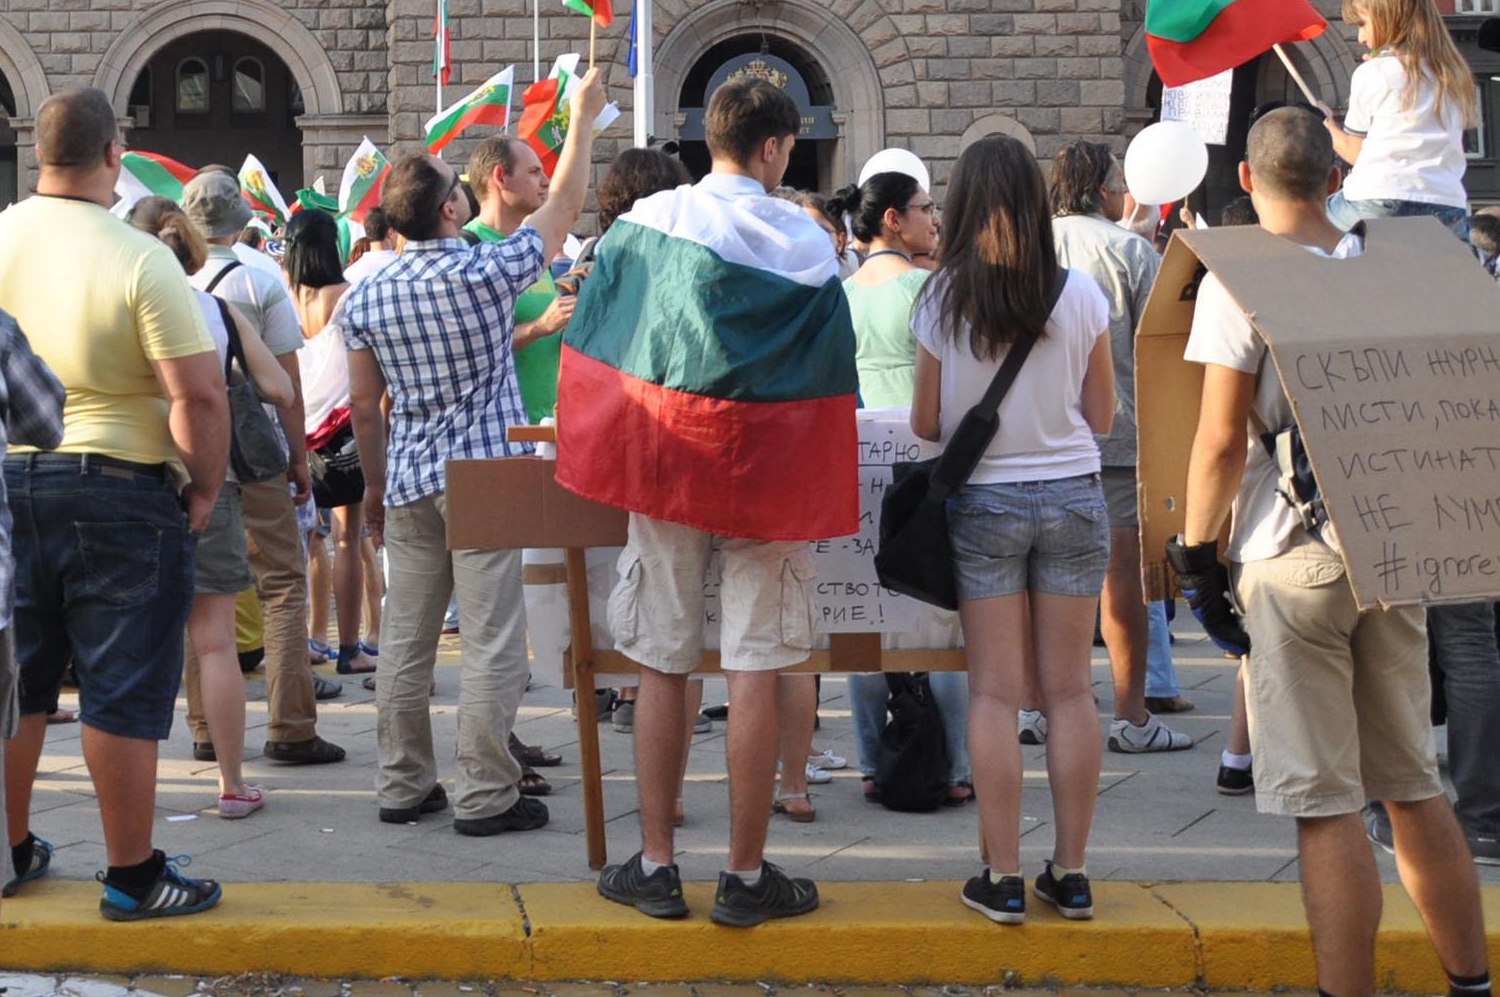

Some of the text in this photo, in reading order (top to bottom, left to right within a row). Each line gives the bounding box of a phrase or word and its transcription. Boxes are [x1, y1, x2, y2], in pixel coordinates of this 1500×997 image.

[1296, 346, 1500, 392] СКЪПИ ЖУРН
[1337, 447, 1500, 479] ИСТИНАТ
[1352, 493, 1413, 532] НЕ
[1373, 540, 1500, 594] #ignore
